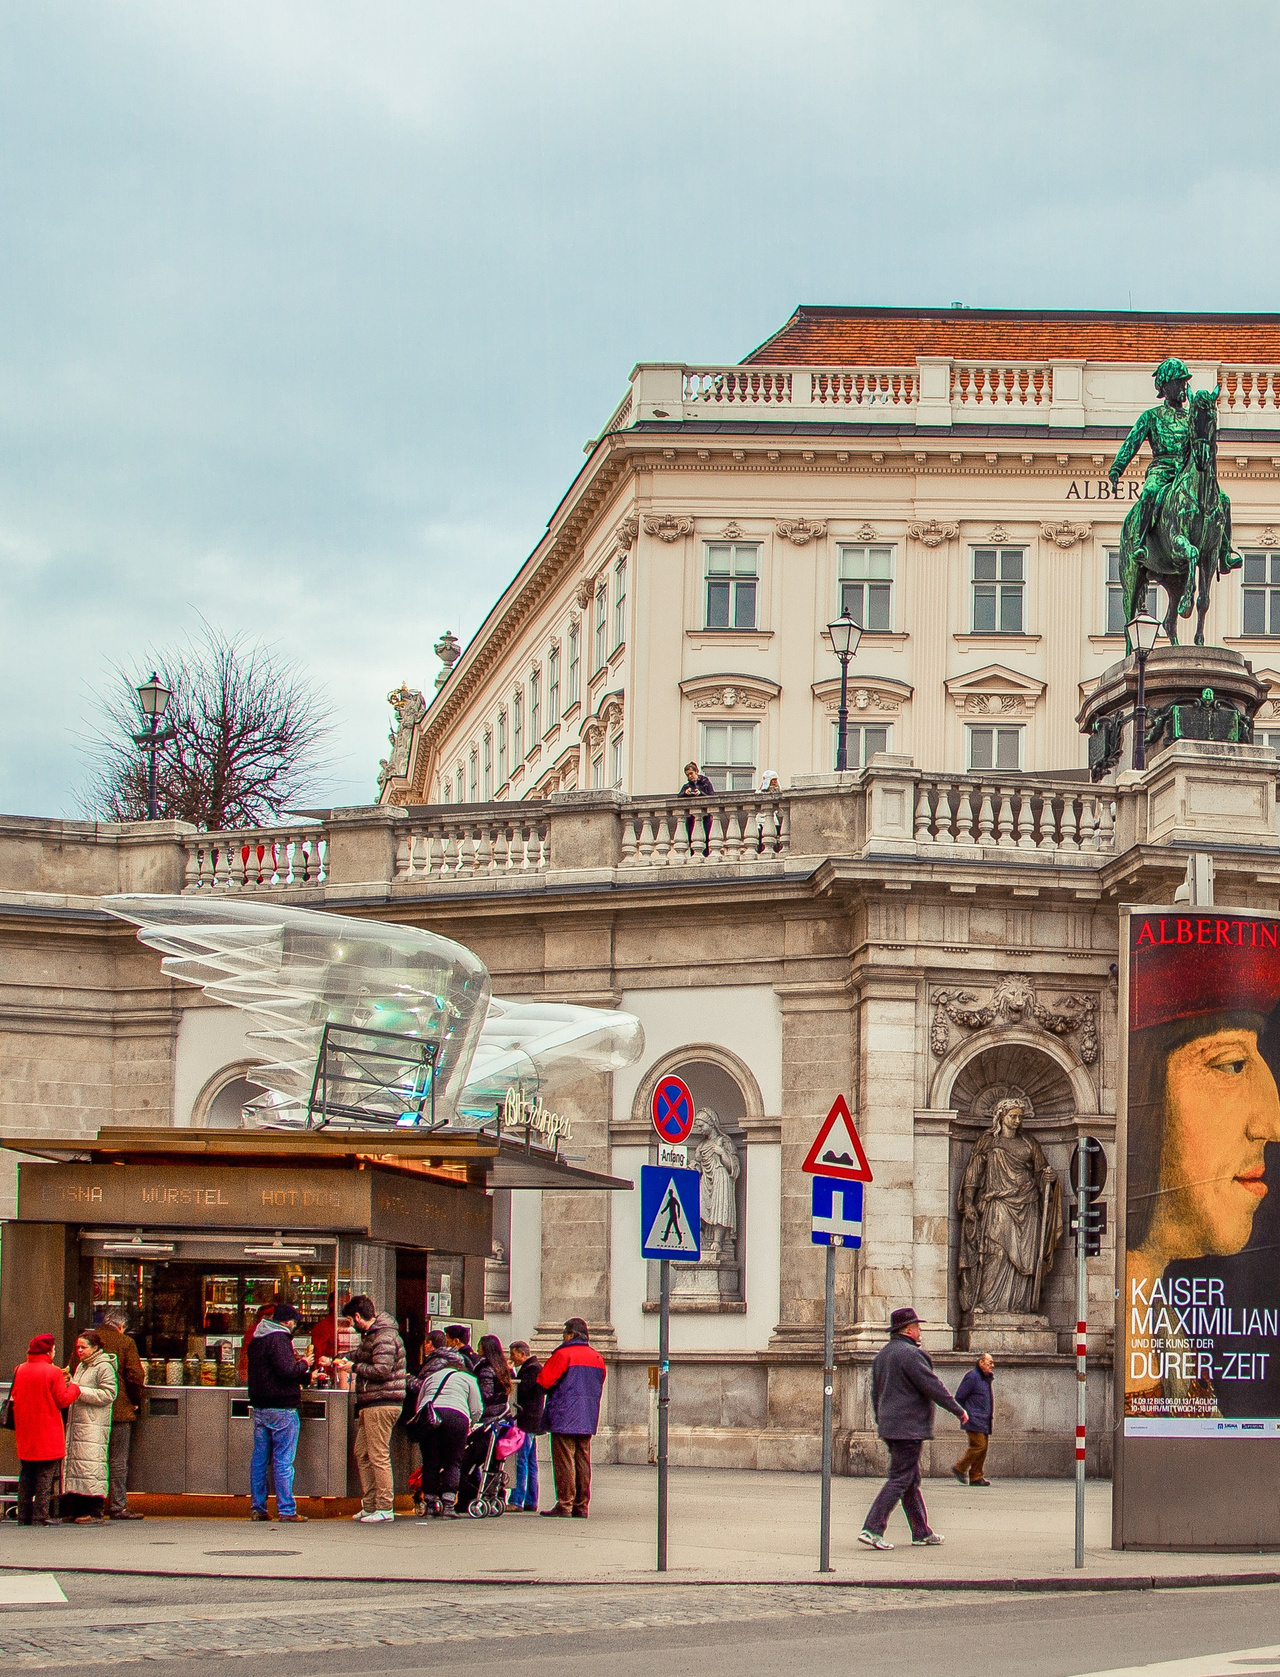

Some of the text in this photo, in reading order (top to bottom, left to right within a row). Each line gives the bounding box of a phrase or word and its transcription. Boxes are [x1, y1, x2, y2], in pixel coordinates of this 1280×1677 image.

[1065, 480, 1144, 500] ALBER
[142, 1184, 229, 1206] WÜRSTEL
[262, 1190, 297, 1207] HOT
[1131, 1278, 1225, 1306] KAISER
[1131, 1307, 1278, 1336] MAXIMILIAN
[1131, 1338, 1214, 1349] UND DIE KUNST DER
[1131, 1349, 1270, 1380] DÜRER-ZEIT
[1131, 1397, 1153, 1405] 14.09.12
[1154, 1397, 1164, 1405] BIS
